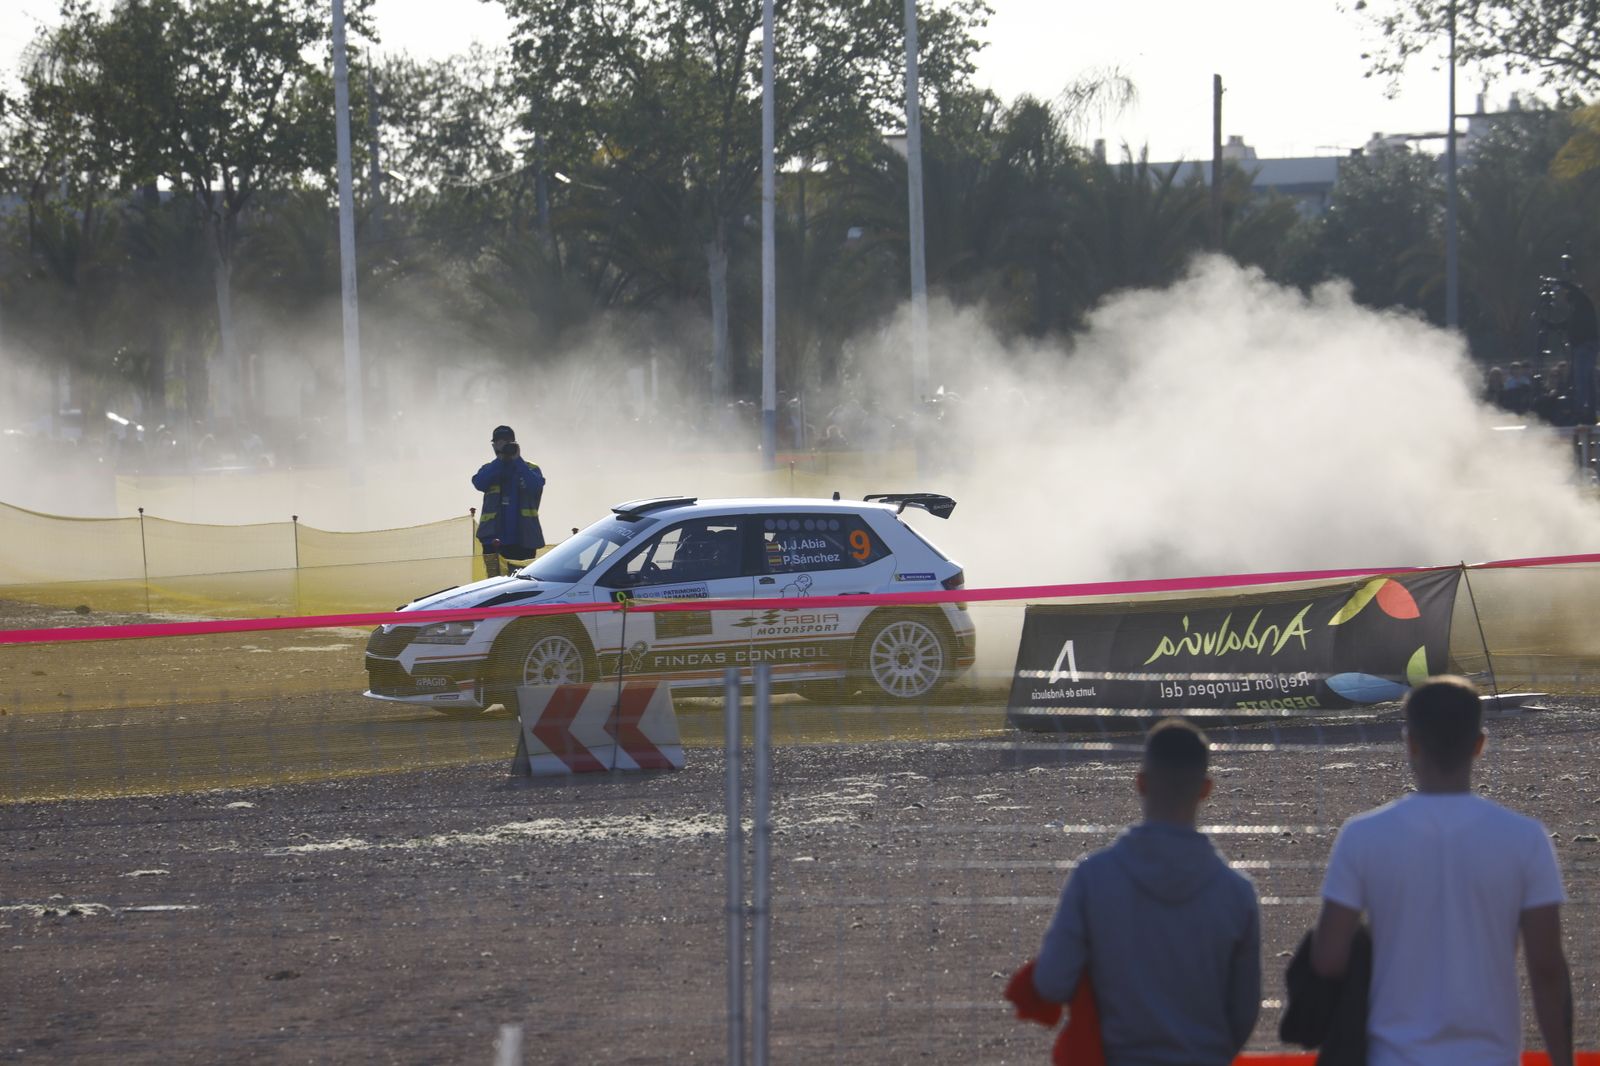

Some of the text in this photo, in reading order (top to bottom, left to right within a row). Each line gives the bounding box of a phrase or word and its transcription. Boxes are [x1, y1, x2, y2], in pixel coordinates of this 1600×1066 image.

[849, 530, 871, 560] 9
[782, 553, 840, 565] P.Sánchez
[784, 613, 839, 624] ABIA
[757, 624, 840, 635] MOTORSPORT
[654, 646, 830, 667] FINCAS CONTROL
